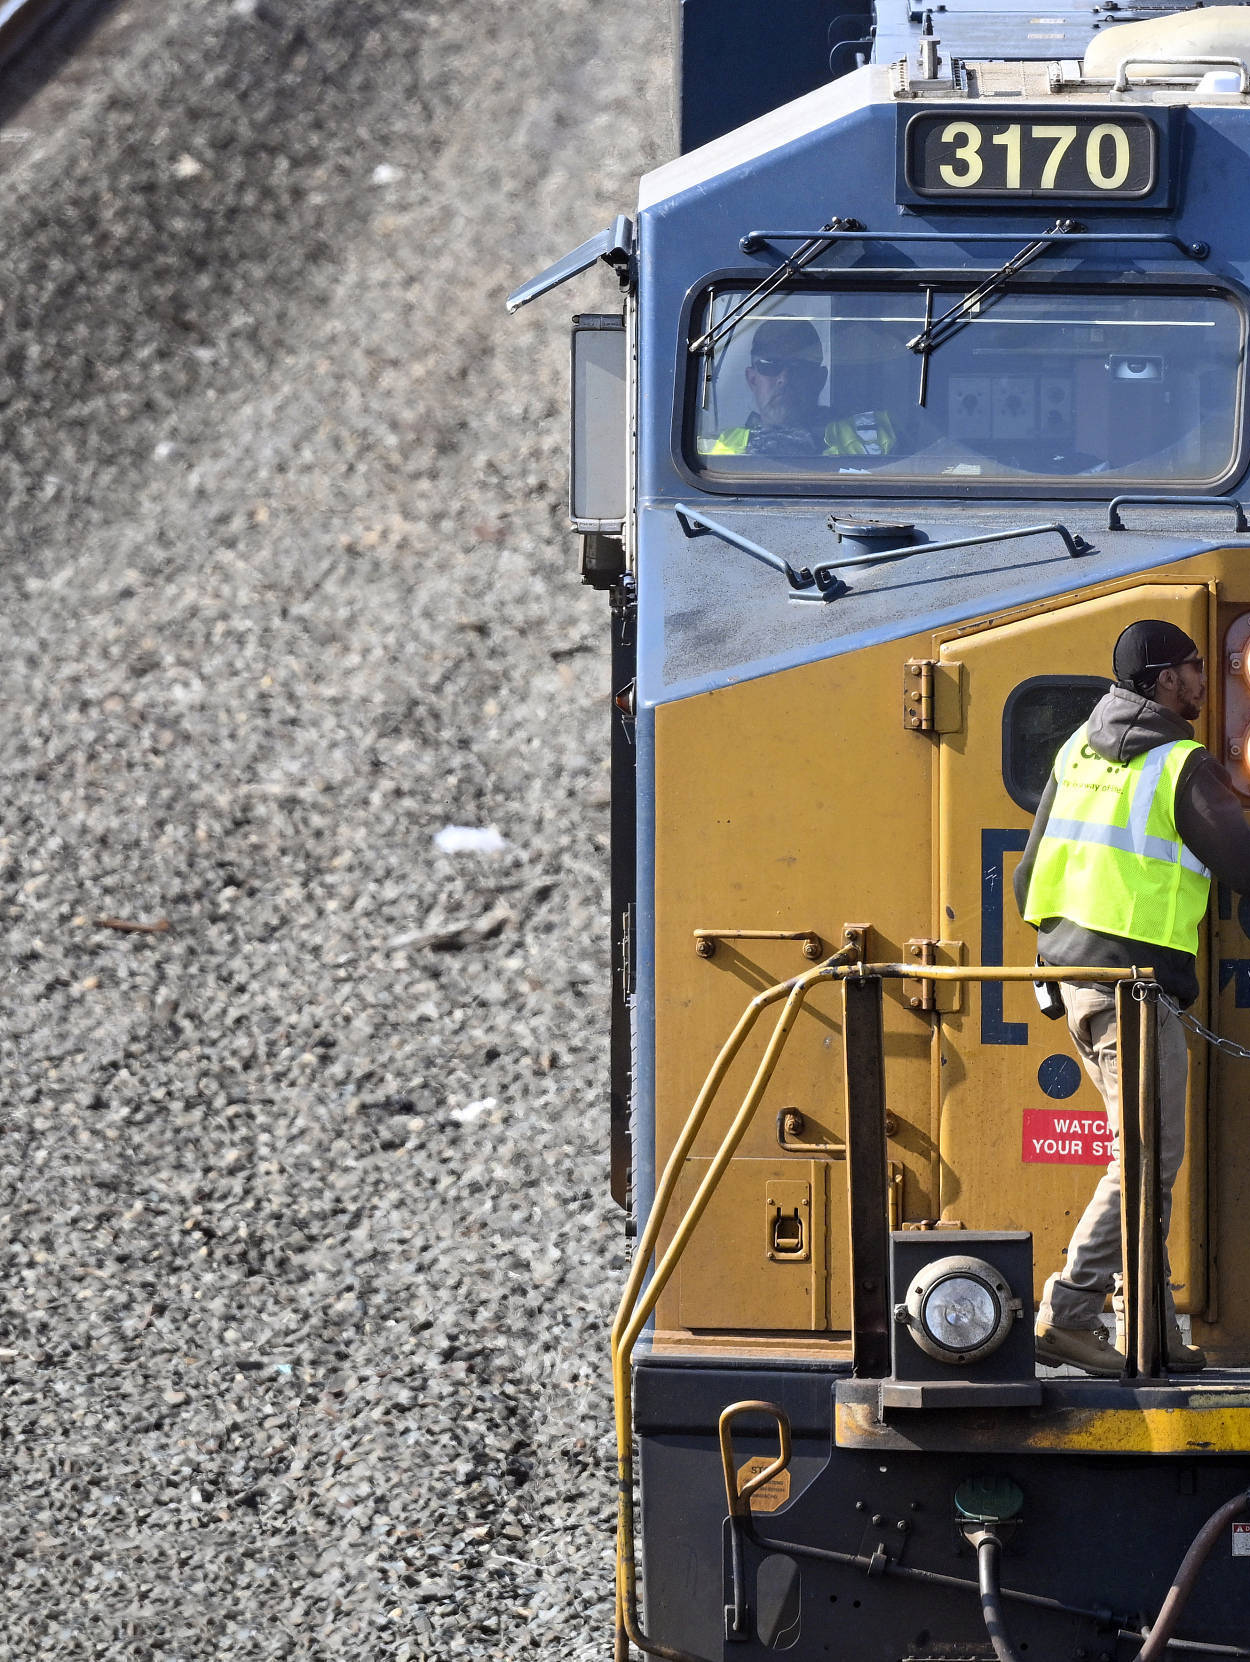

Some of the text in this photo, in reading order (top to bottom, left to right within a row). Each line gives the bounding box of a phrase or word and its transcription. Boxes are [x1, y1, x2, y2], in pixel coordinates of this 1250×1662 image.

[939, 122, 1130, 189] 3170
[1032, 1139, 1113, 1156] YOUR ST
